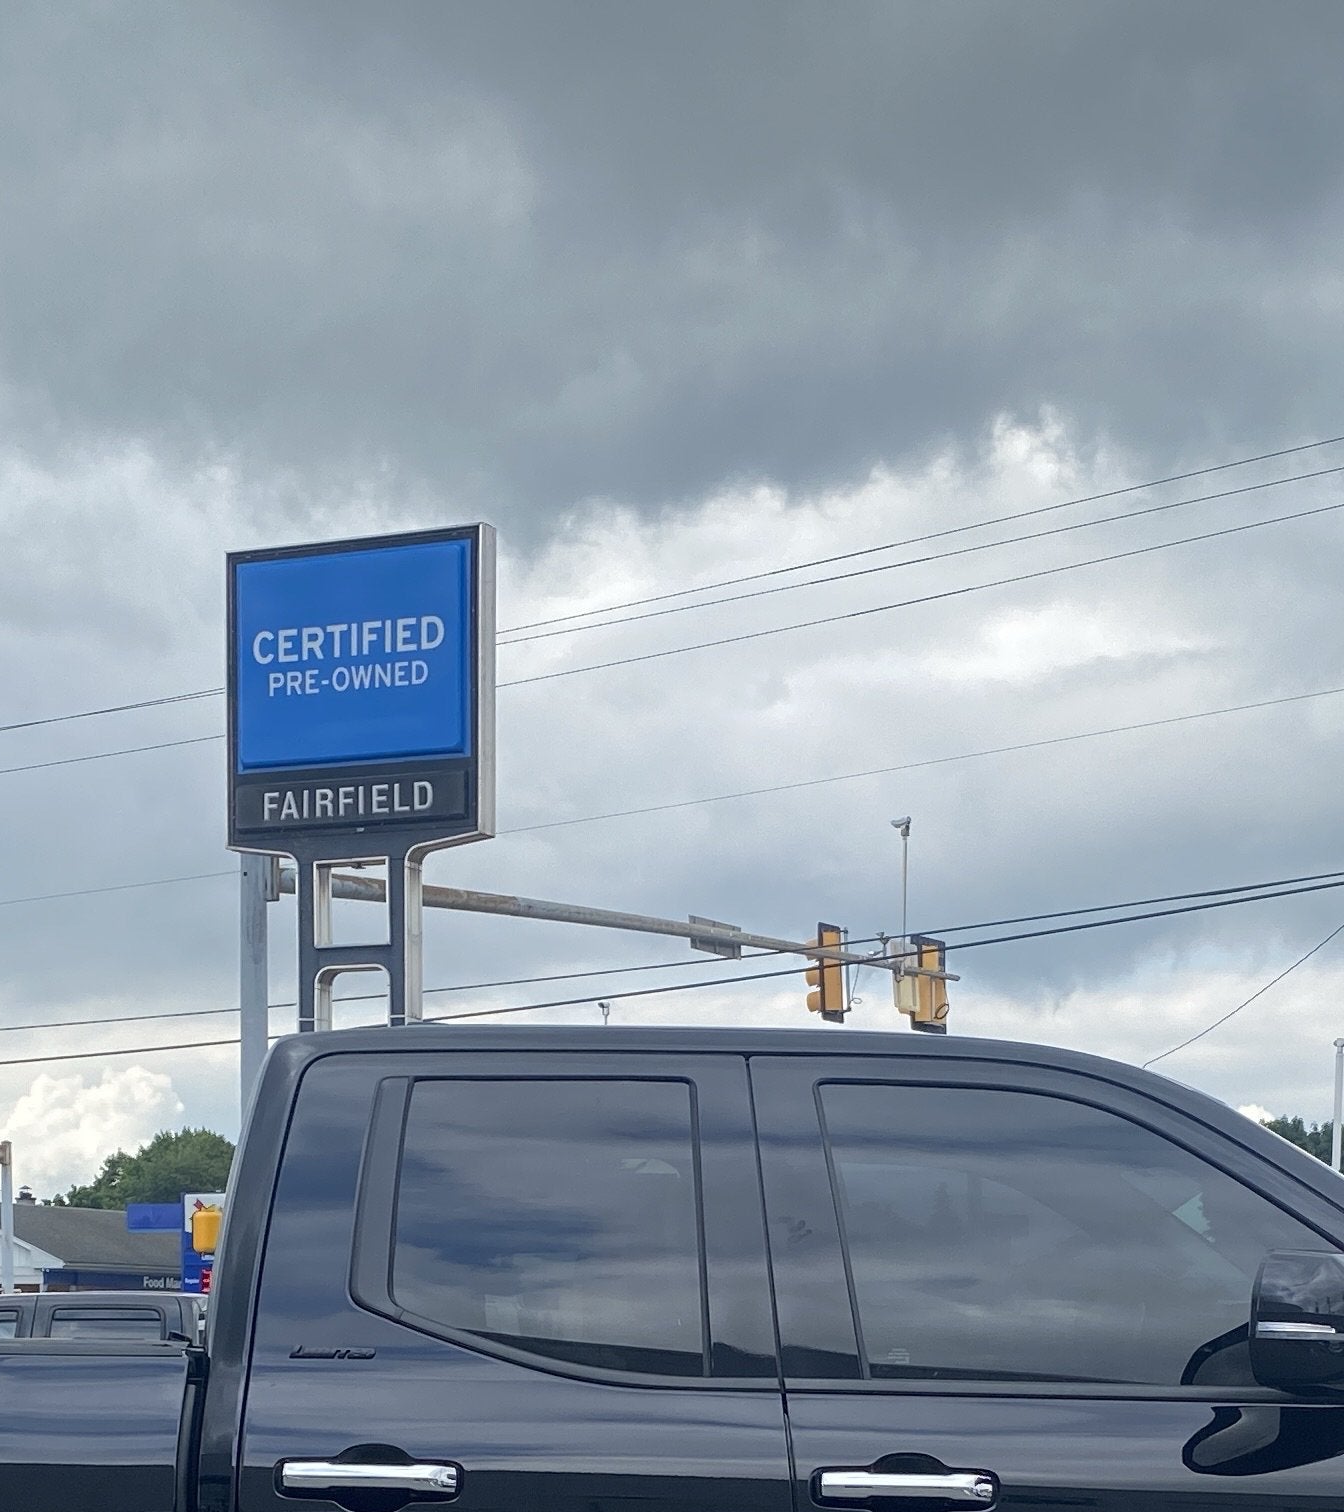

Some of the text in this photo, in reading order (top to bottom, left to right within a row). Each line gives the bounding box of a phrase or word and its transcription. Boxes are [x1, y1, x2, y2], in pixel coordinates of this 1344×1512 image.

[252, 615, 445, 665] CERTIFIED
[268, 660, 430, 697] PRE-OWNED
[262, 780, 434, 821] FAIRFIELD
[143, 1276, 164, 1289] Food
